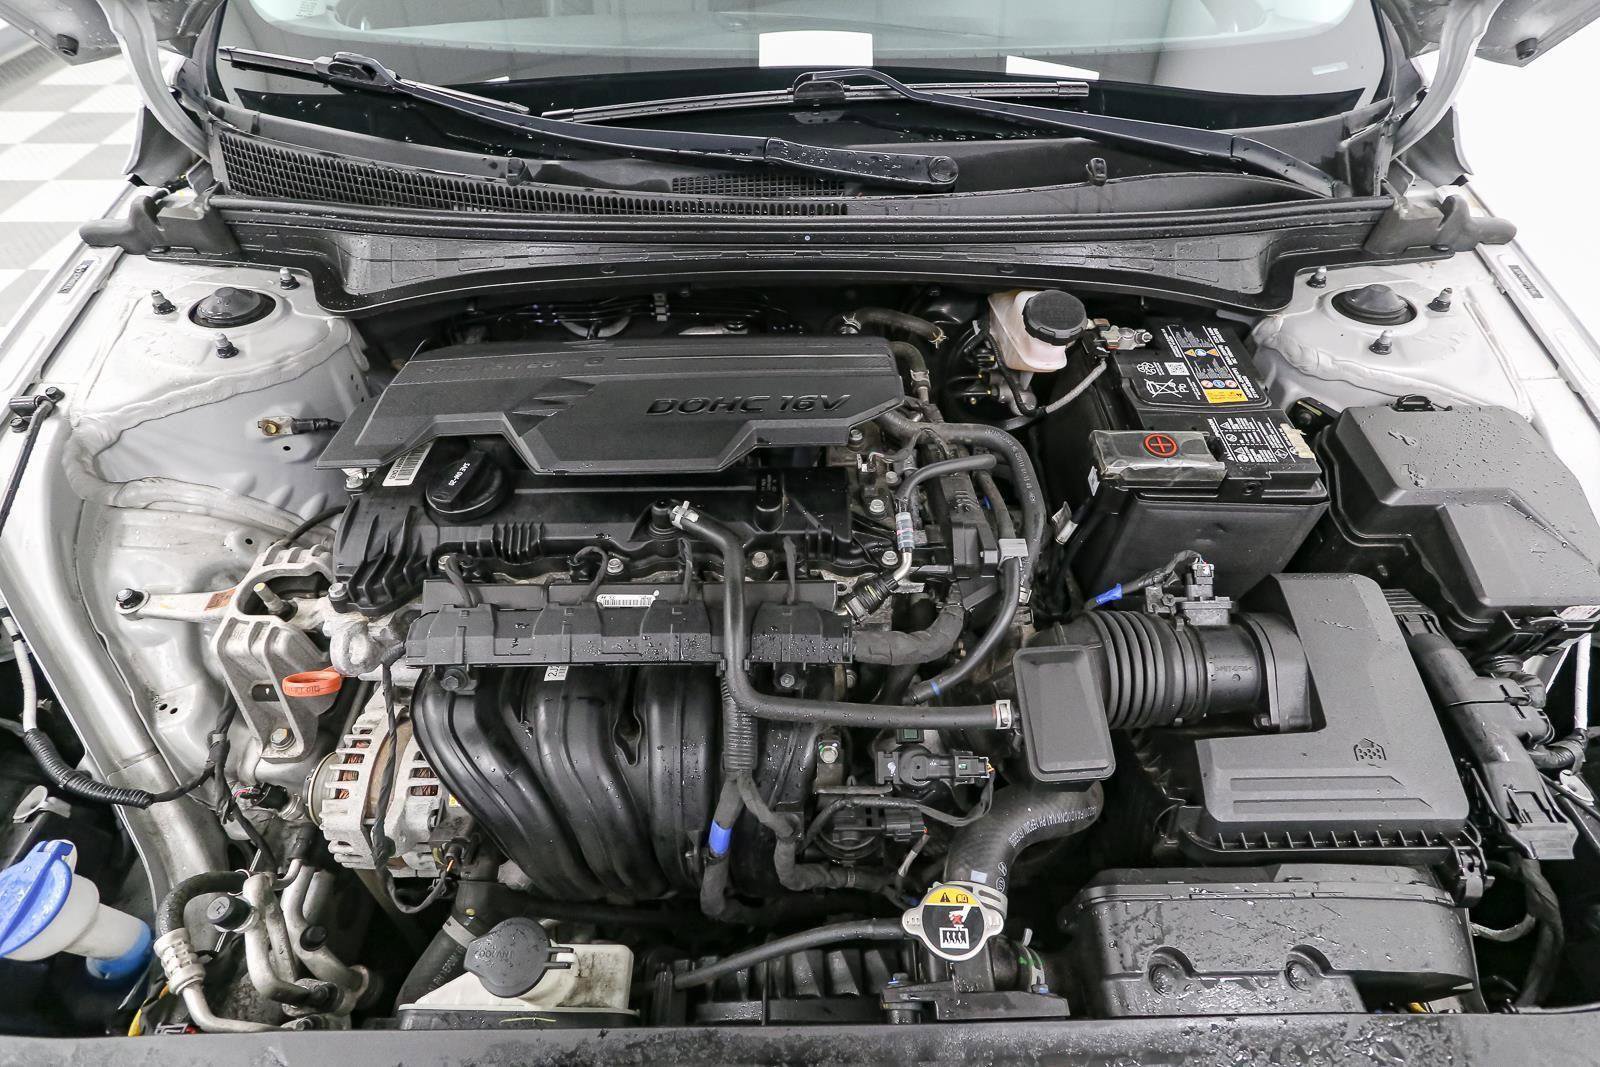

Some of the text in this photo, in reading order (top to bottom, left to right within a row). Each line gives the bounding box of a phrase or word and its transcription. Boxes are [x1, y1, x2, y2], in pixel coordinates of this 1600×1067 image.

[1179, 383, 1189, 393] Pb
[648, 394, 851, 415] DOHC 16V
[459, 462, 470, 472] SAE
[474, 950, 514, 960] COOLANT
